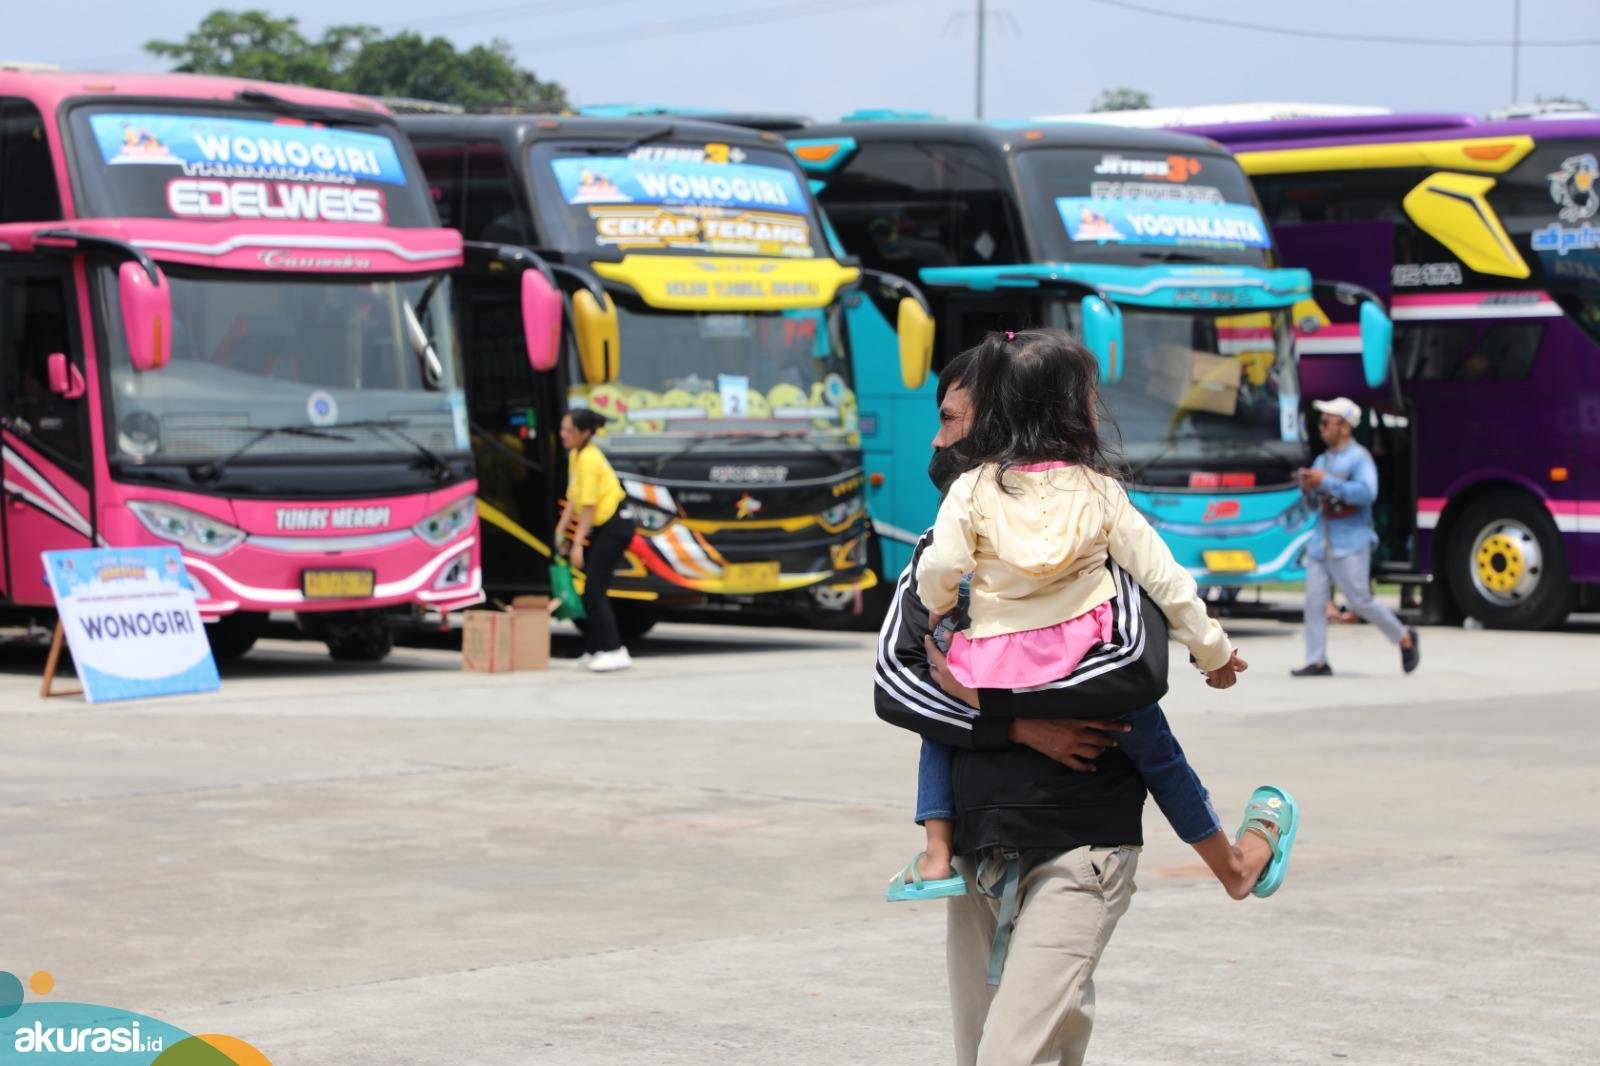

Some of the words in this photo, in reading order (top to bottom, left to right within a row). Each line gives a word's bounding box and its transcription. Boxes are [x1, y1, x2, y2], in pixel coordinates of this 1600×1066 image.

[193, 133, 381, 176] WONOGIRI
[168, 179, 385, 224] EDELWEIS
[636, 172, 790, 206] WONOGIRI
[598, 217, 699, 237] CEKAP
[702, 219, 807, 245] TERANG
[1127, 213, 1263, 241] YOGYAKARTA
[275, 508, 329, 531] TUNAS
[332, 507, 391, 529] MERAPI
[80, 609, 195, 641] WONOGIRI
